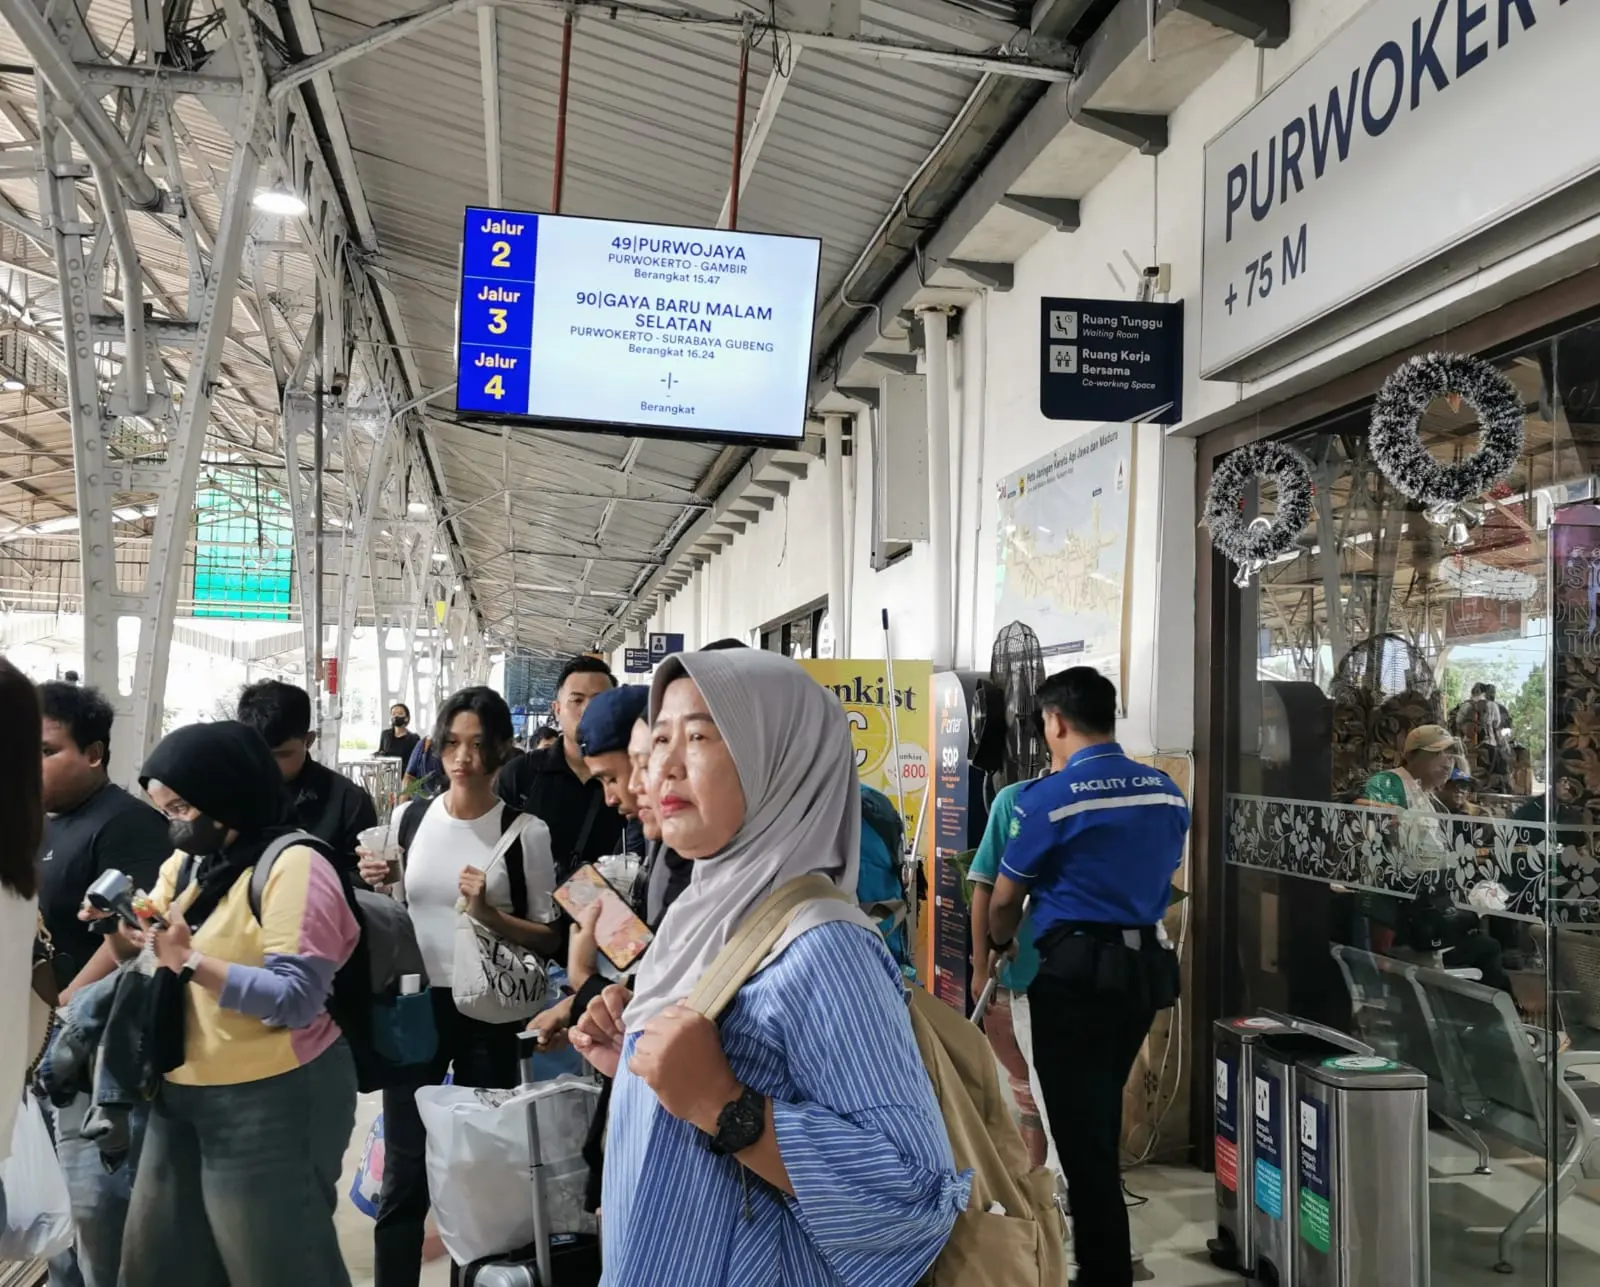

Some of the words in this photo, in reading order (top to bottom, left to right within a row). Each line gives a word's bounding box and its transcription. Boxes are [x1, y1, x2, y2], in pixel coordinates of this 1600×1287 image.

[481, 218, 524, 236] Jalur
[491, 241, 511, 268] 2
[608, 253, 691, 270] PURWOKERTO
[700, 261, 748, 275] GAMBIR
[1245, 250, 1272, 307] 75
[1282, 223, 1307, 285] M
[634, 268, 691, 285] Berangkat
[693, 273, 720, 285] 15.47
[477, 285, 521, 303] Jalur
[656, 297, 700, 315] BARU
[706, 302, 772, 321] MALAM
[487, 308, 507, 335] 3
[635, 314, 712, 333] SELATAN
[1082, 313, 1118, 327] Ruang
[1120, 315, 1163, 330] Tunggu
[570, 325, 653, 343] PURWOKERTO
[662, 333, 722, 348] SURABAYA
[725, 338, 774, 353] GUBENG
[1082, 328, 1114, 340] Waiting
[1116, 330, 1139, 339] Room
[474, 352, 517, 370] Jalur
[628, 344, 685, 360] Berangkat
[687, 348, 715, 360] 16.24
[1082, 348, 1118, 362] Ruang
[1120, 350, 1151, 363] Kerja
[1082, 364, 1130, 376] Bersama
[484, 375, 505, 400] 4
[1082, 378, 1129, 390] Co-working
[1131, 380, 1156, 390] Space
[640, 401, 695, 415] Berangkat
[1068, 450, 1076, 462] Api
[1077, 446, 1089, 459] Jawa
[1090, 440, 1098, 452] dan
[1099, 430, 1118, 447] Madura
[942, 747, 959, 767] SOP
[1070, 777, 1127, 793] FACILITY
[1131, 776, 1164, 787] CARE
